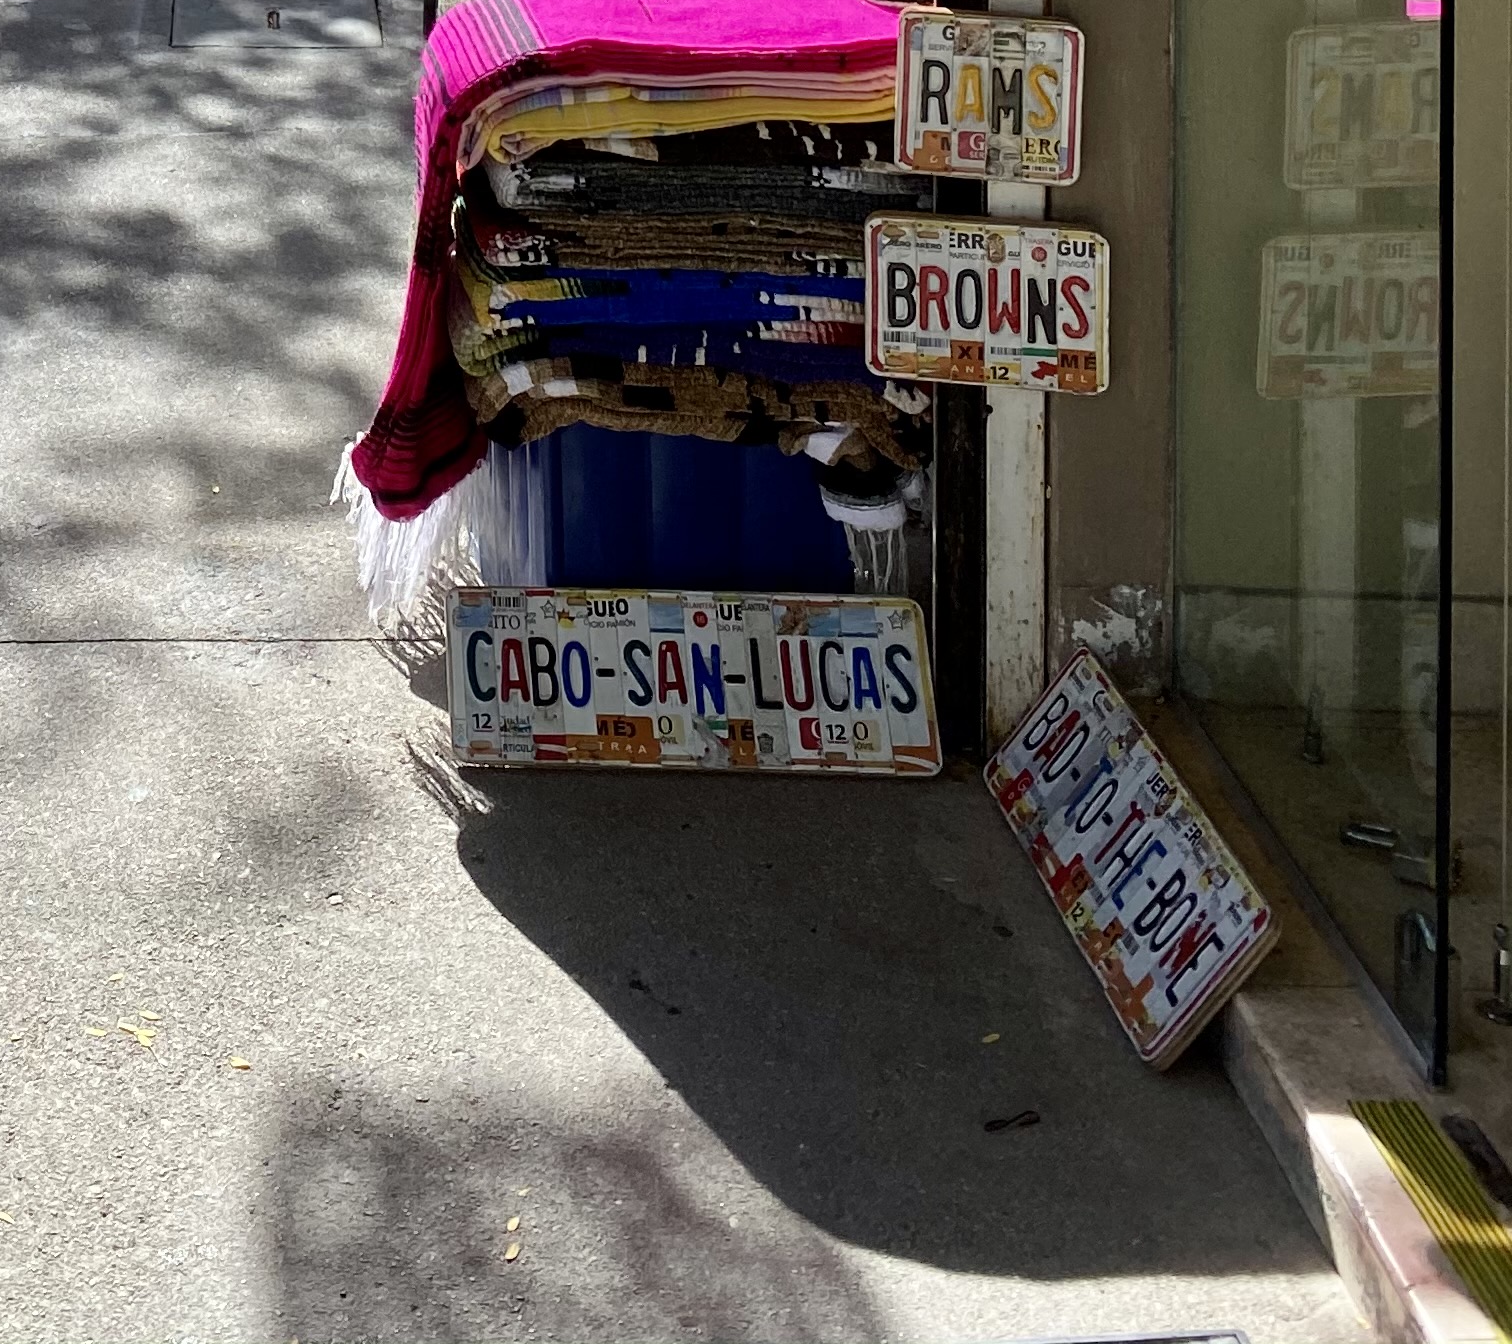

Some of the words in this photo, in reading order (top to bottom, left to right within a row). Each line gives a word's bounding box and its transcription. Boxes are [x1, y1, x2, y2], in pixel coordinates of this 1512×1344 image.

[920, 59, 1059, 135] RAMS
[888, 262, 1090, 345] BROWNS
[466, 630, 918, 716] CABO-SAN-LUCAS
[472, 713, 493, 730] 12
[825, 723, 847, 741] 12
[1023, 692, 1224, 1008] BAD-TO-THE-BONE
